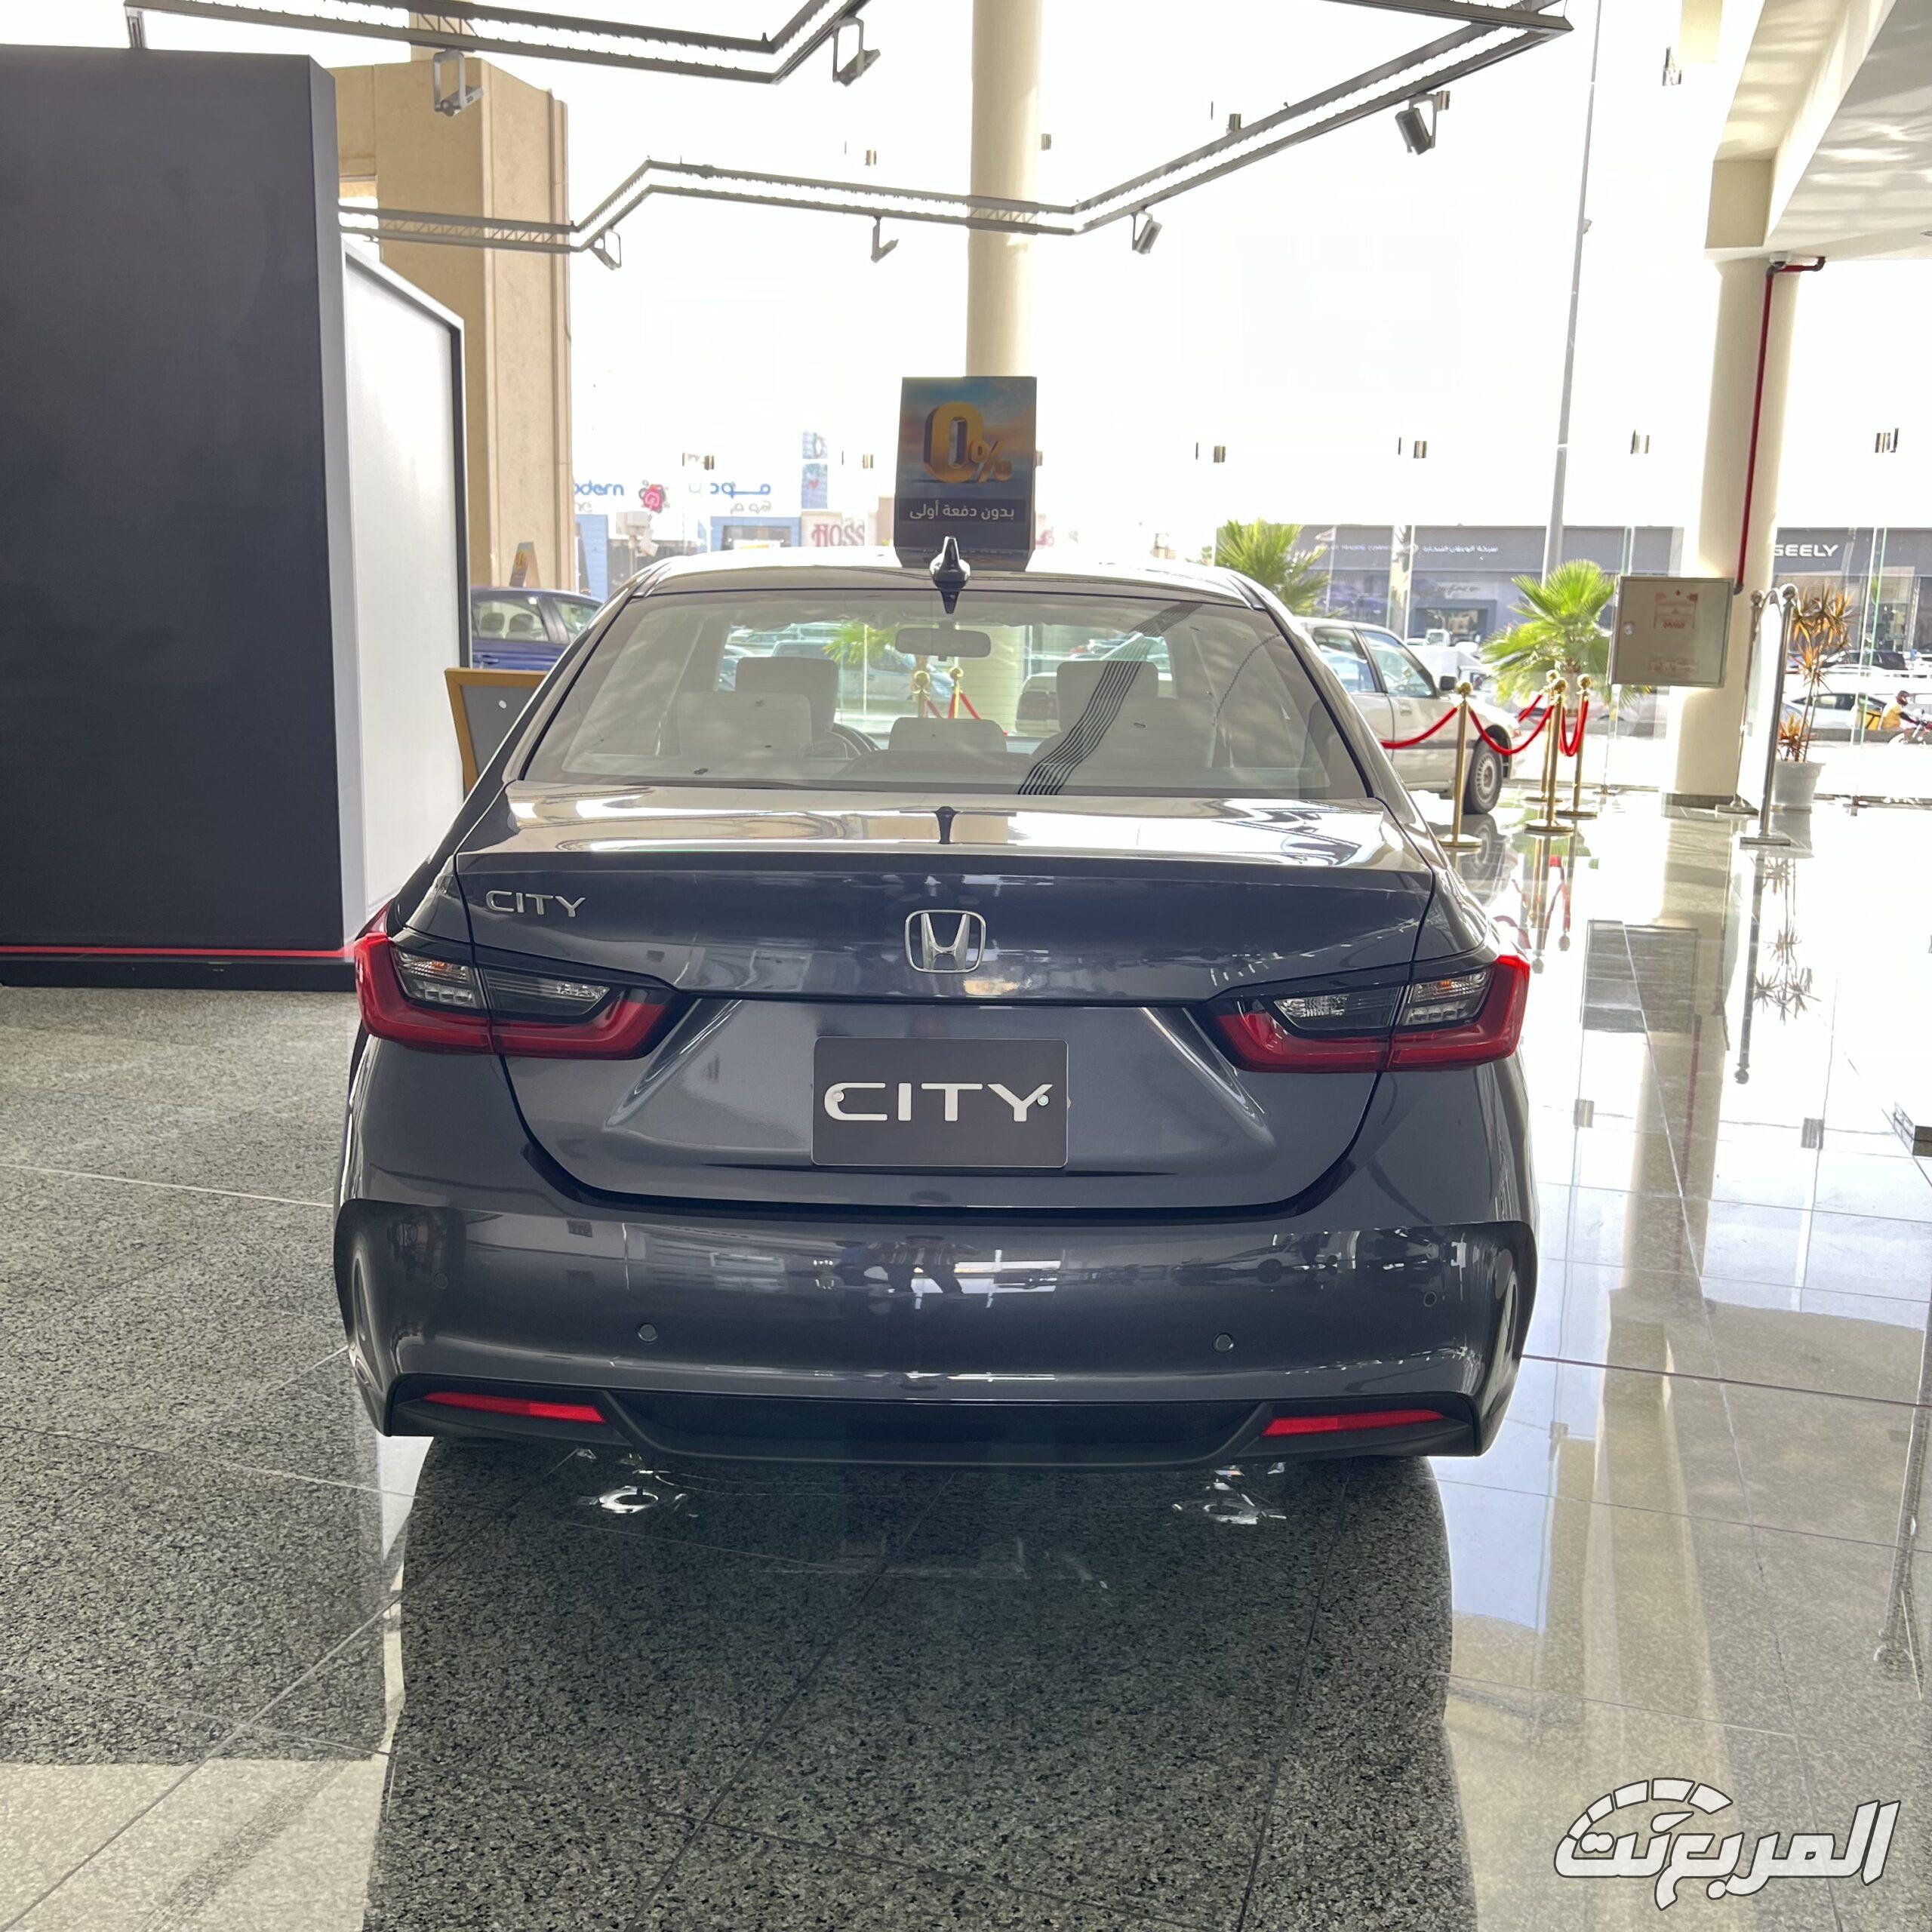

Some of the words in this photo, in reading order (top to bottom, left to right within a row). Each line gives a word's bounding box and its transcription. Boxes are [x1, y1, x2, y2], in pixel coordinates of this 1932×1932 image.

[924, 401, 1012, 483] 0%
[574, 480, 624, 496] odern
[909, 500, 939, 519] أولى
[943, 503, 977, 517] دفعة
[980, 506, 1014, 520] بدون
[1774, 543, 1839, 557] GEELY
[485, 890, 586, 918] CITY
[823, 1082, 1054, 1122] CITY
